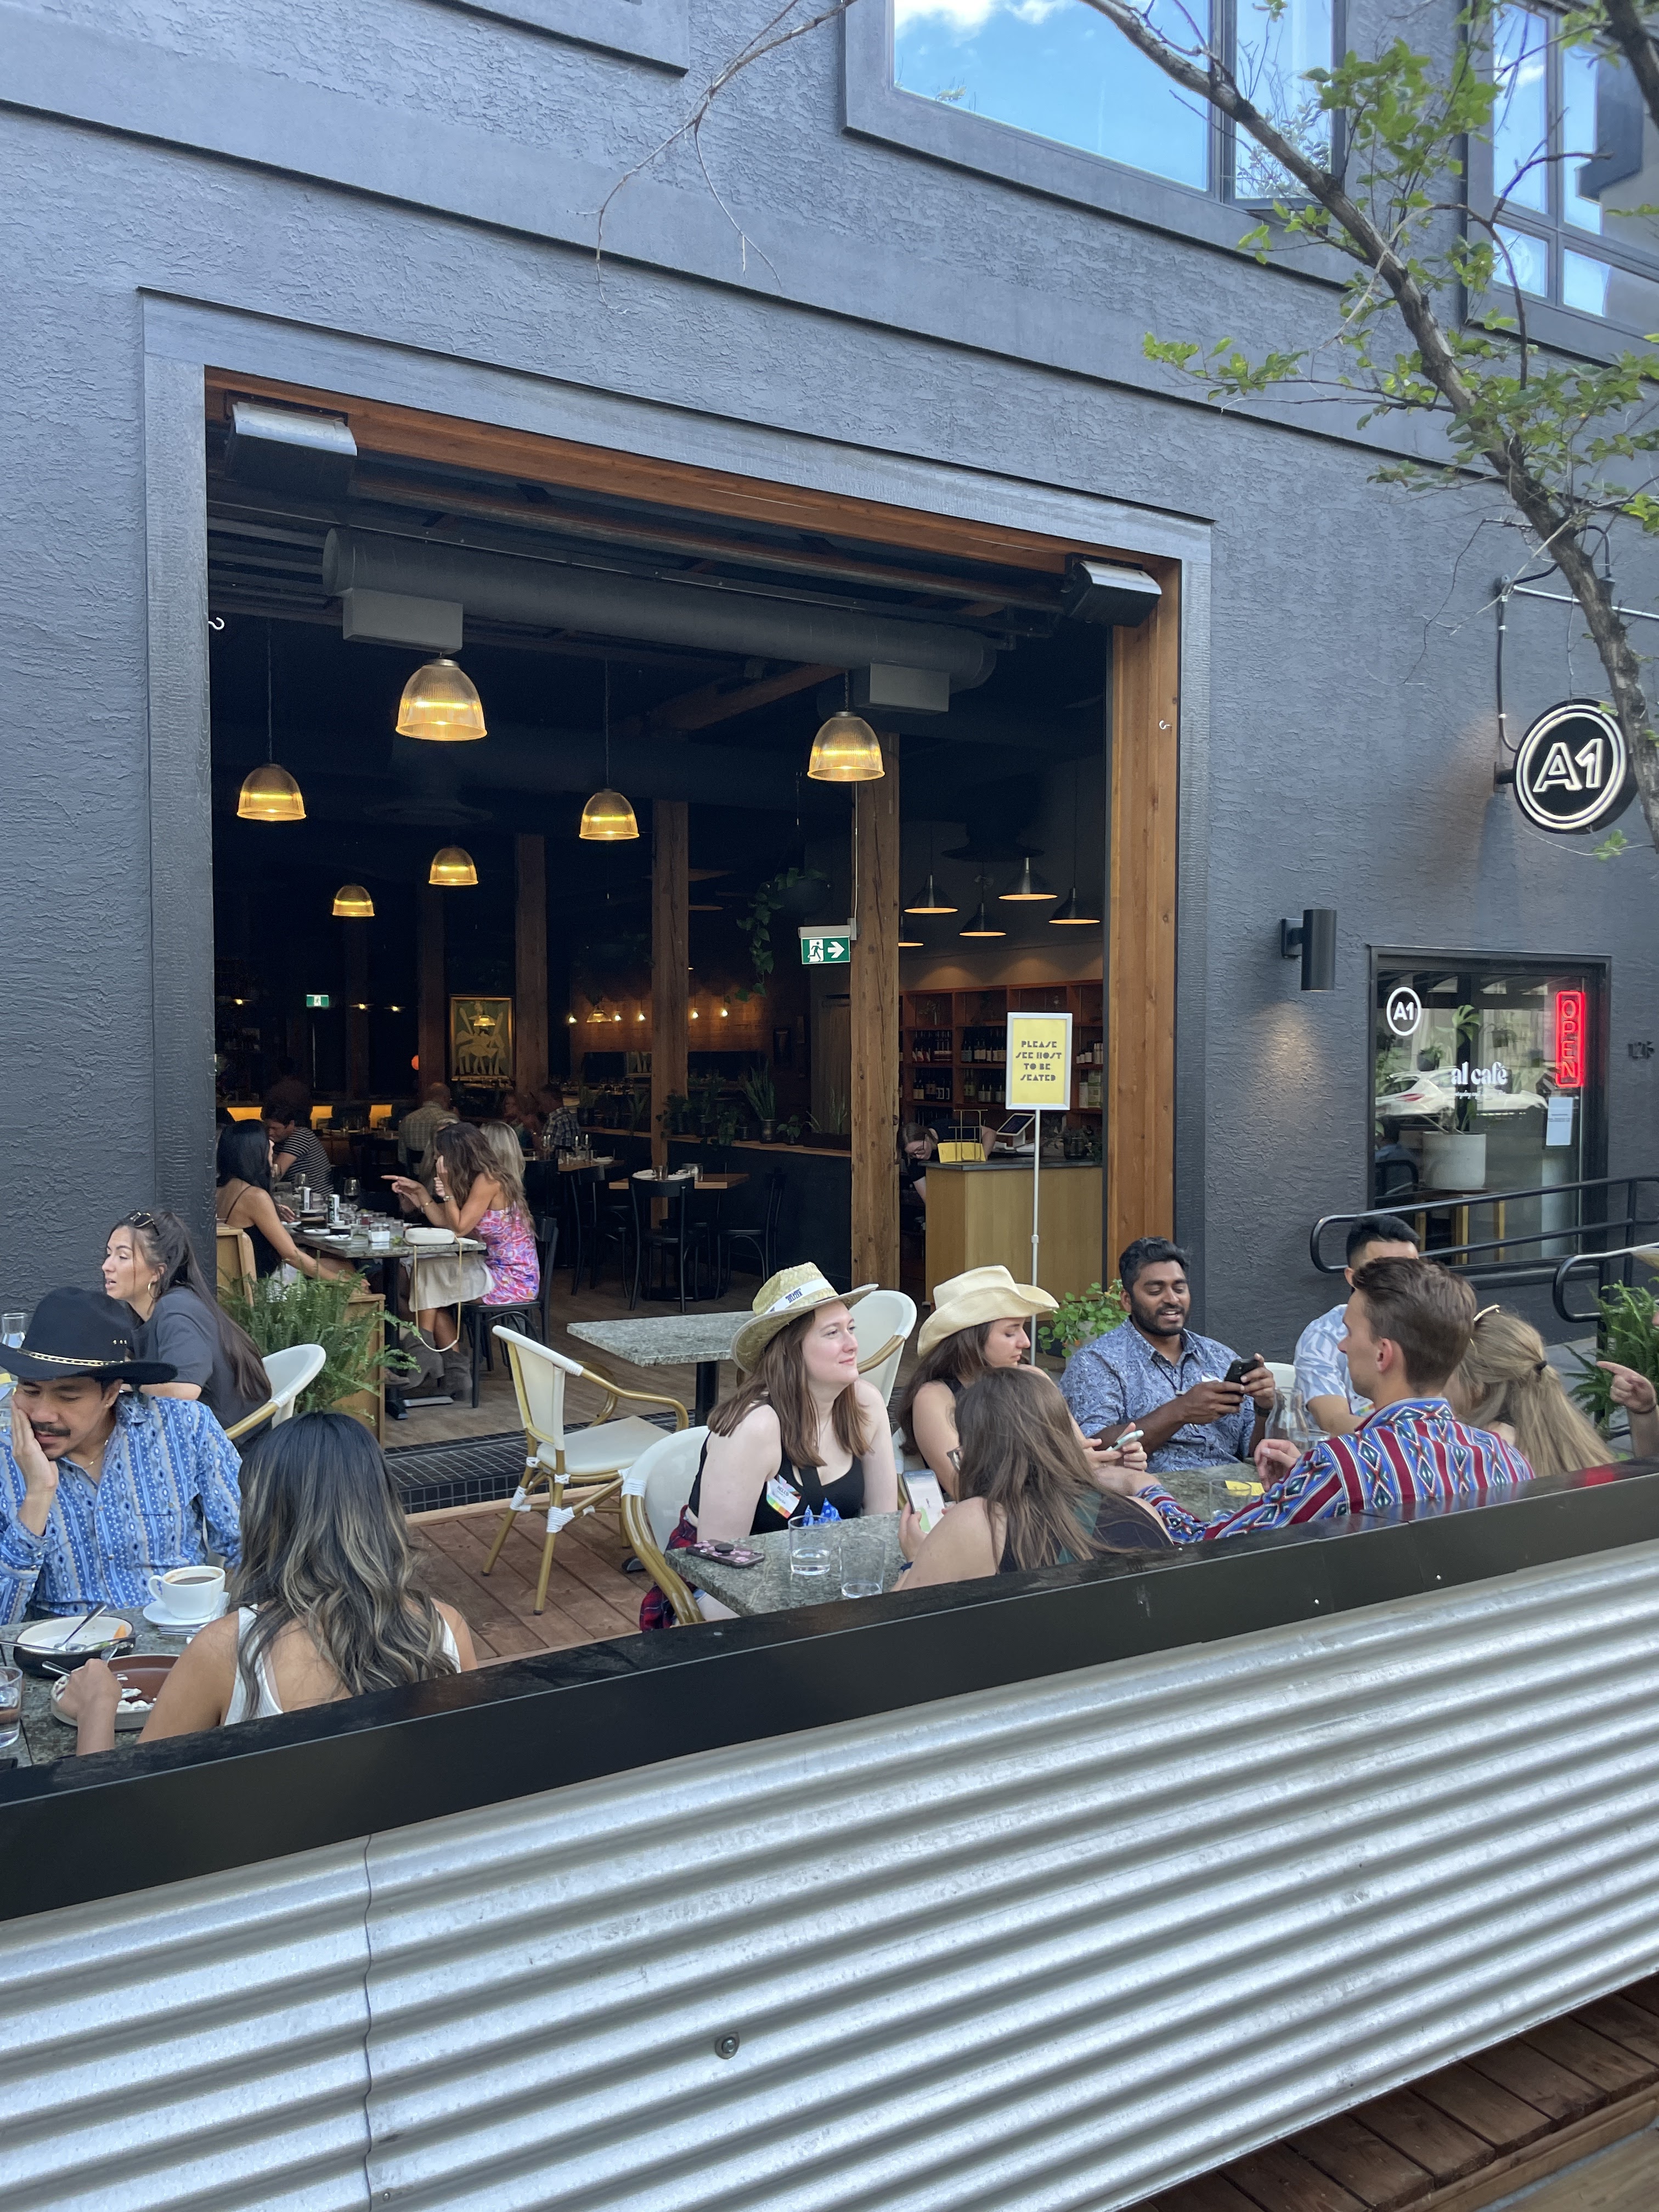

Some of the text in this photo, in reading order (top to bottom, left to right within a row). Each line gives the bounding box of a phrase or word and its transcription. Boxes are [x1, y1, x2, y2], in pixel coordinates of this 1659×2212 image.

[1532, 738, 1605, 793] A1
[1393, 1001, 1414, 1020] A1
[1561, 1000, 1578, 1078] OPEN
